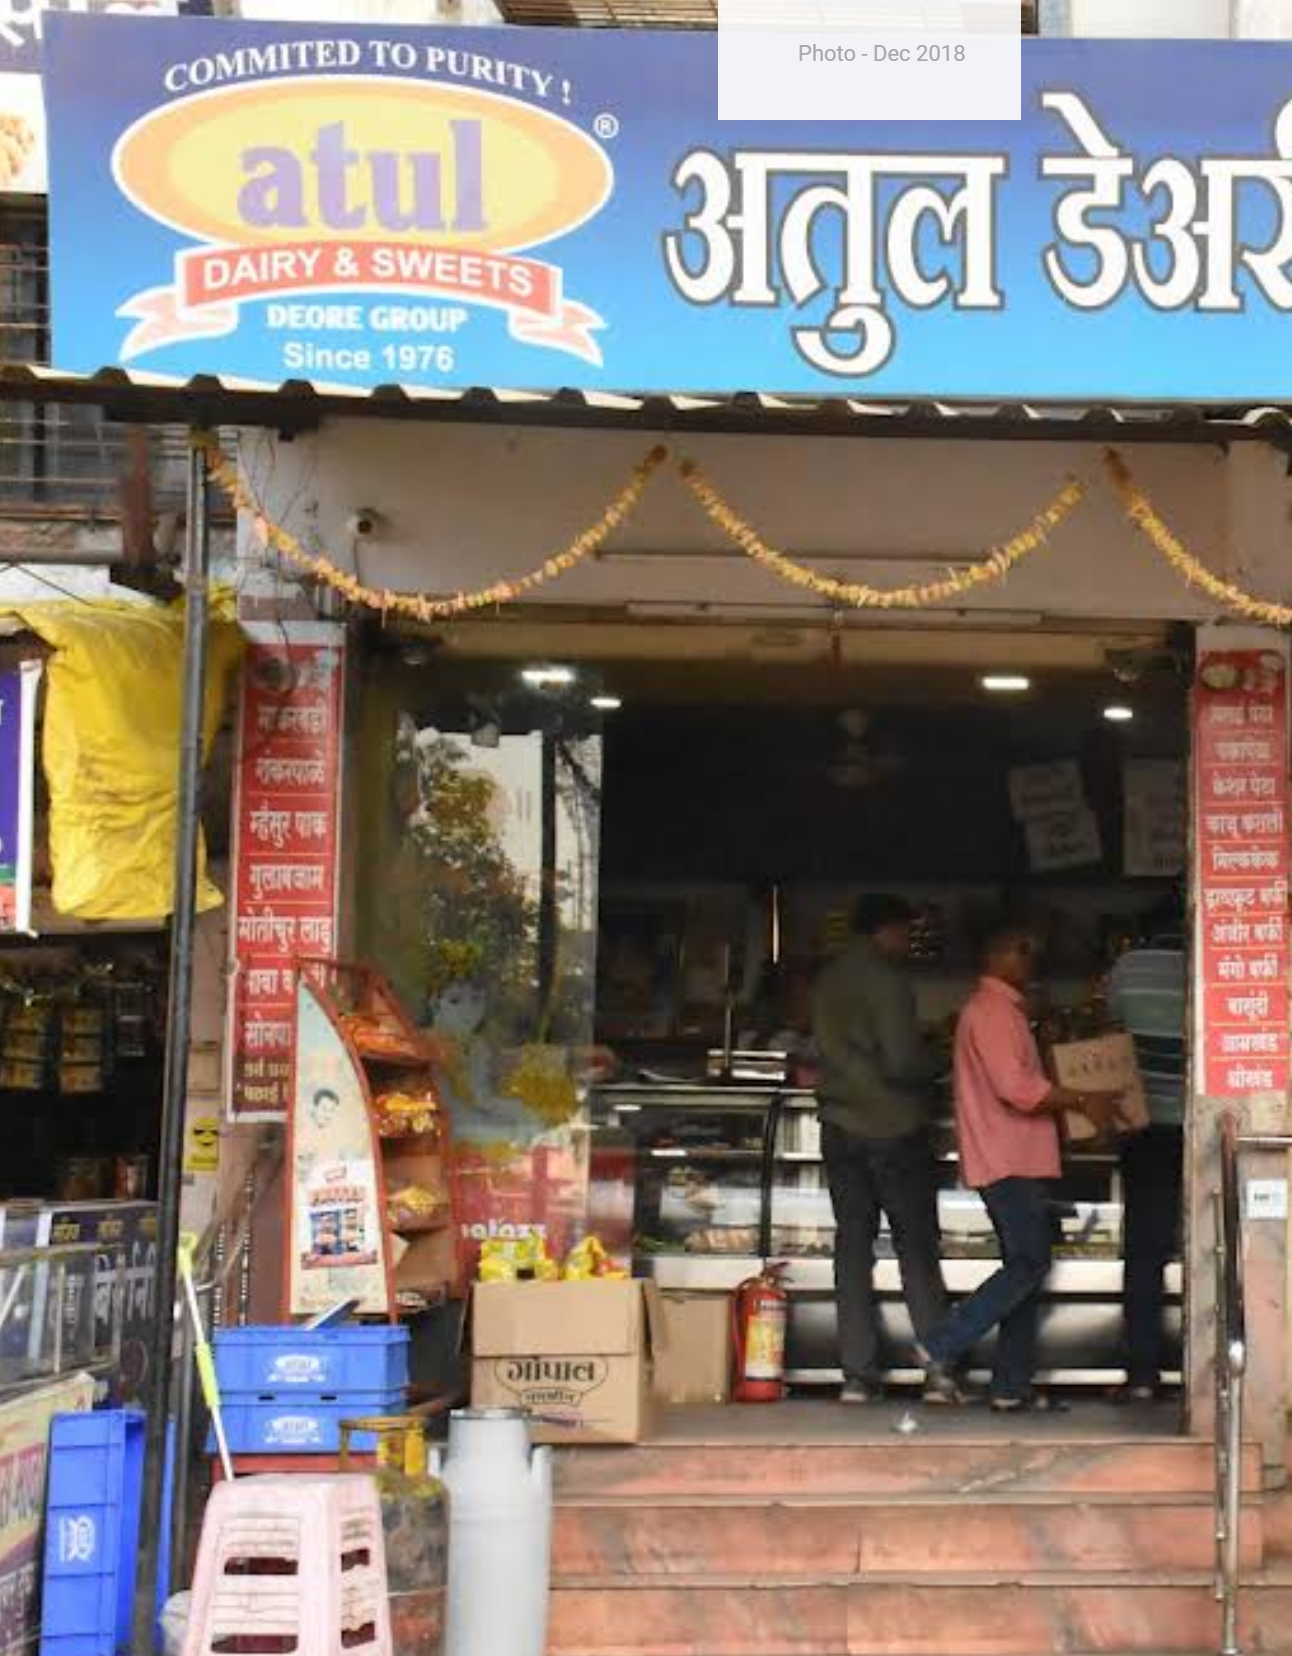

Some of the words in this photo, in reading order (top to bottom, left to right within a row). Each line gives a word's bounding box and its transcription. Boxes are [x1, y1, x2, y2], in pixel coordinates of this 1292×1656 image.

[164, 40, 360, 92] COMMITED
[370, 41, 416, 69] TO
[237, 119, 489, 234] atul
[204, 248, 323, 291] DAIRY
[334, 249, 360, 278] &
[372, 248, 534, 297] SWEETS
[663, 148, 1008, 378] अतुल
[267, 305, 362, 331] DEORE
[371, 306, 467, 332] GROUP
[284, 343, 371, 370] Since
[381, 345, 455, 372] 1976
